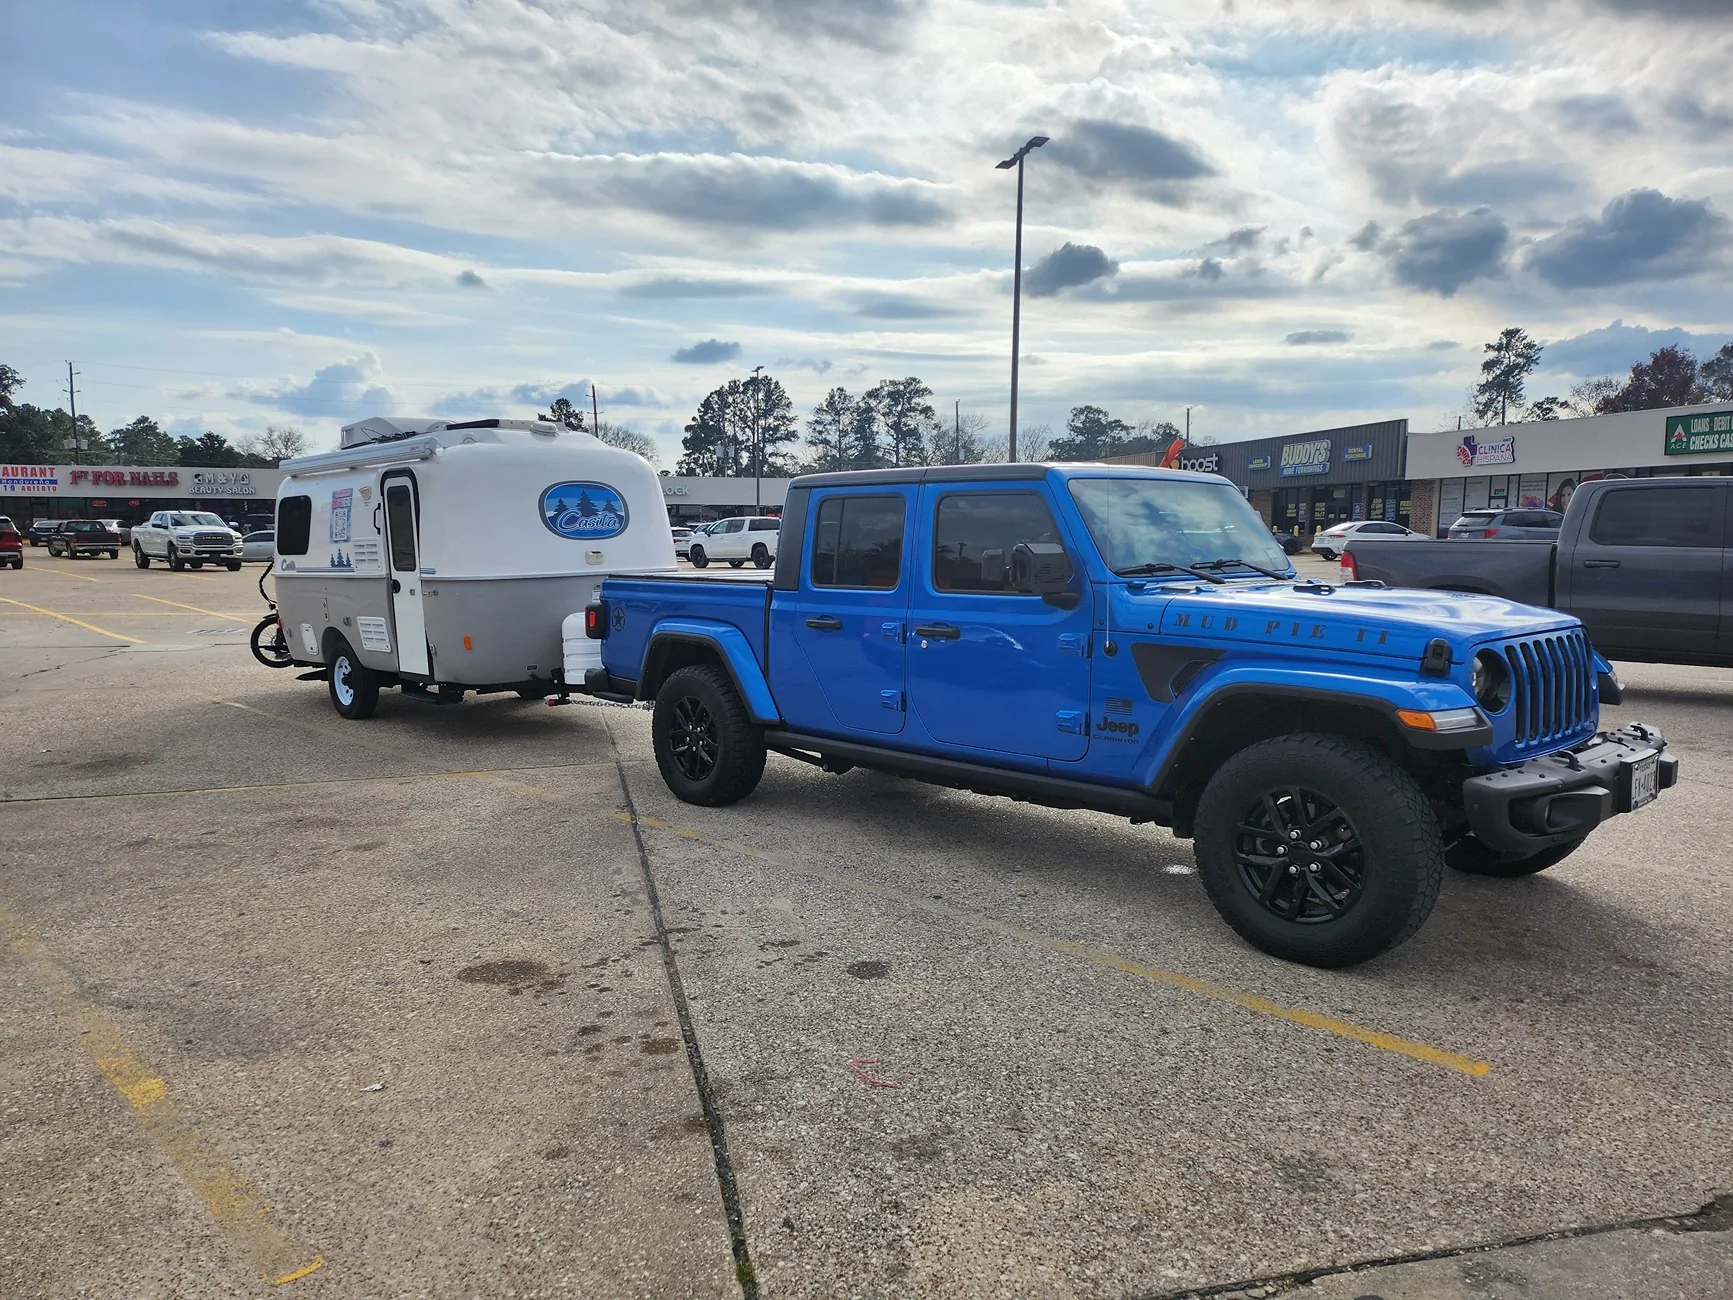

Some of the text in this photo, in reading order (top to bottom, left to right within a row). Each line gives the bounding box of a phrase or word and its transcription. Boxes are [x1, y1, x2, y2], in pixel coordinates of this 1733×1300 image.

[1691, 416, 1730, 433] LOANS DEBIT
[1478, 444, 1511, 454] CLINICA
[1690, 435, 1719, 450] CHECKS
[1281, 440, 1328, 466] BUDDY'S
[1477, 454, 1513, 463] HISPANA
[1181, 453, 1218, 471] boost
[0, 466, 56, 477] AURANT
[91, 471, 127, 486] FOR
[130, 471, 179, 486] NAILS
[189, 486, 255, 495] BEAUTY SALON
[556, 509, 619, 532] Casita
[1174, 613, 1389, 645] MUD PIE II
[1096, 716, 1139, 737] Jeep
[1092, 733, 1139, 744] GLADIATOR
